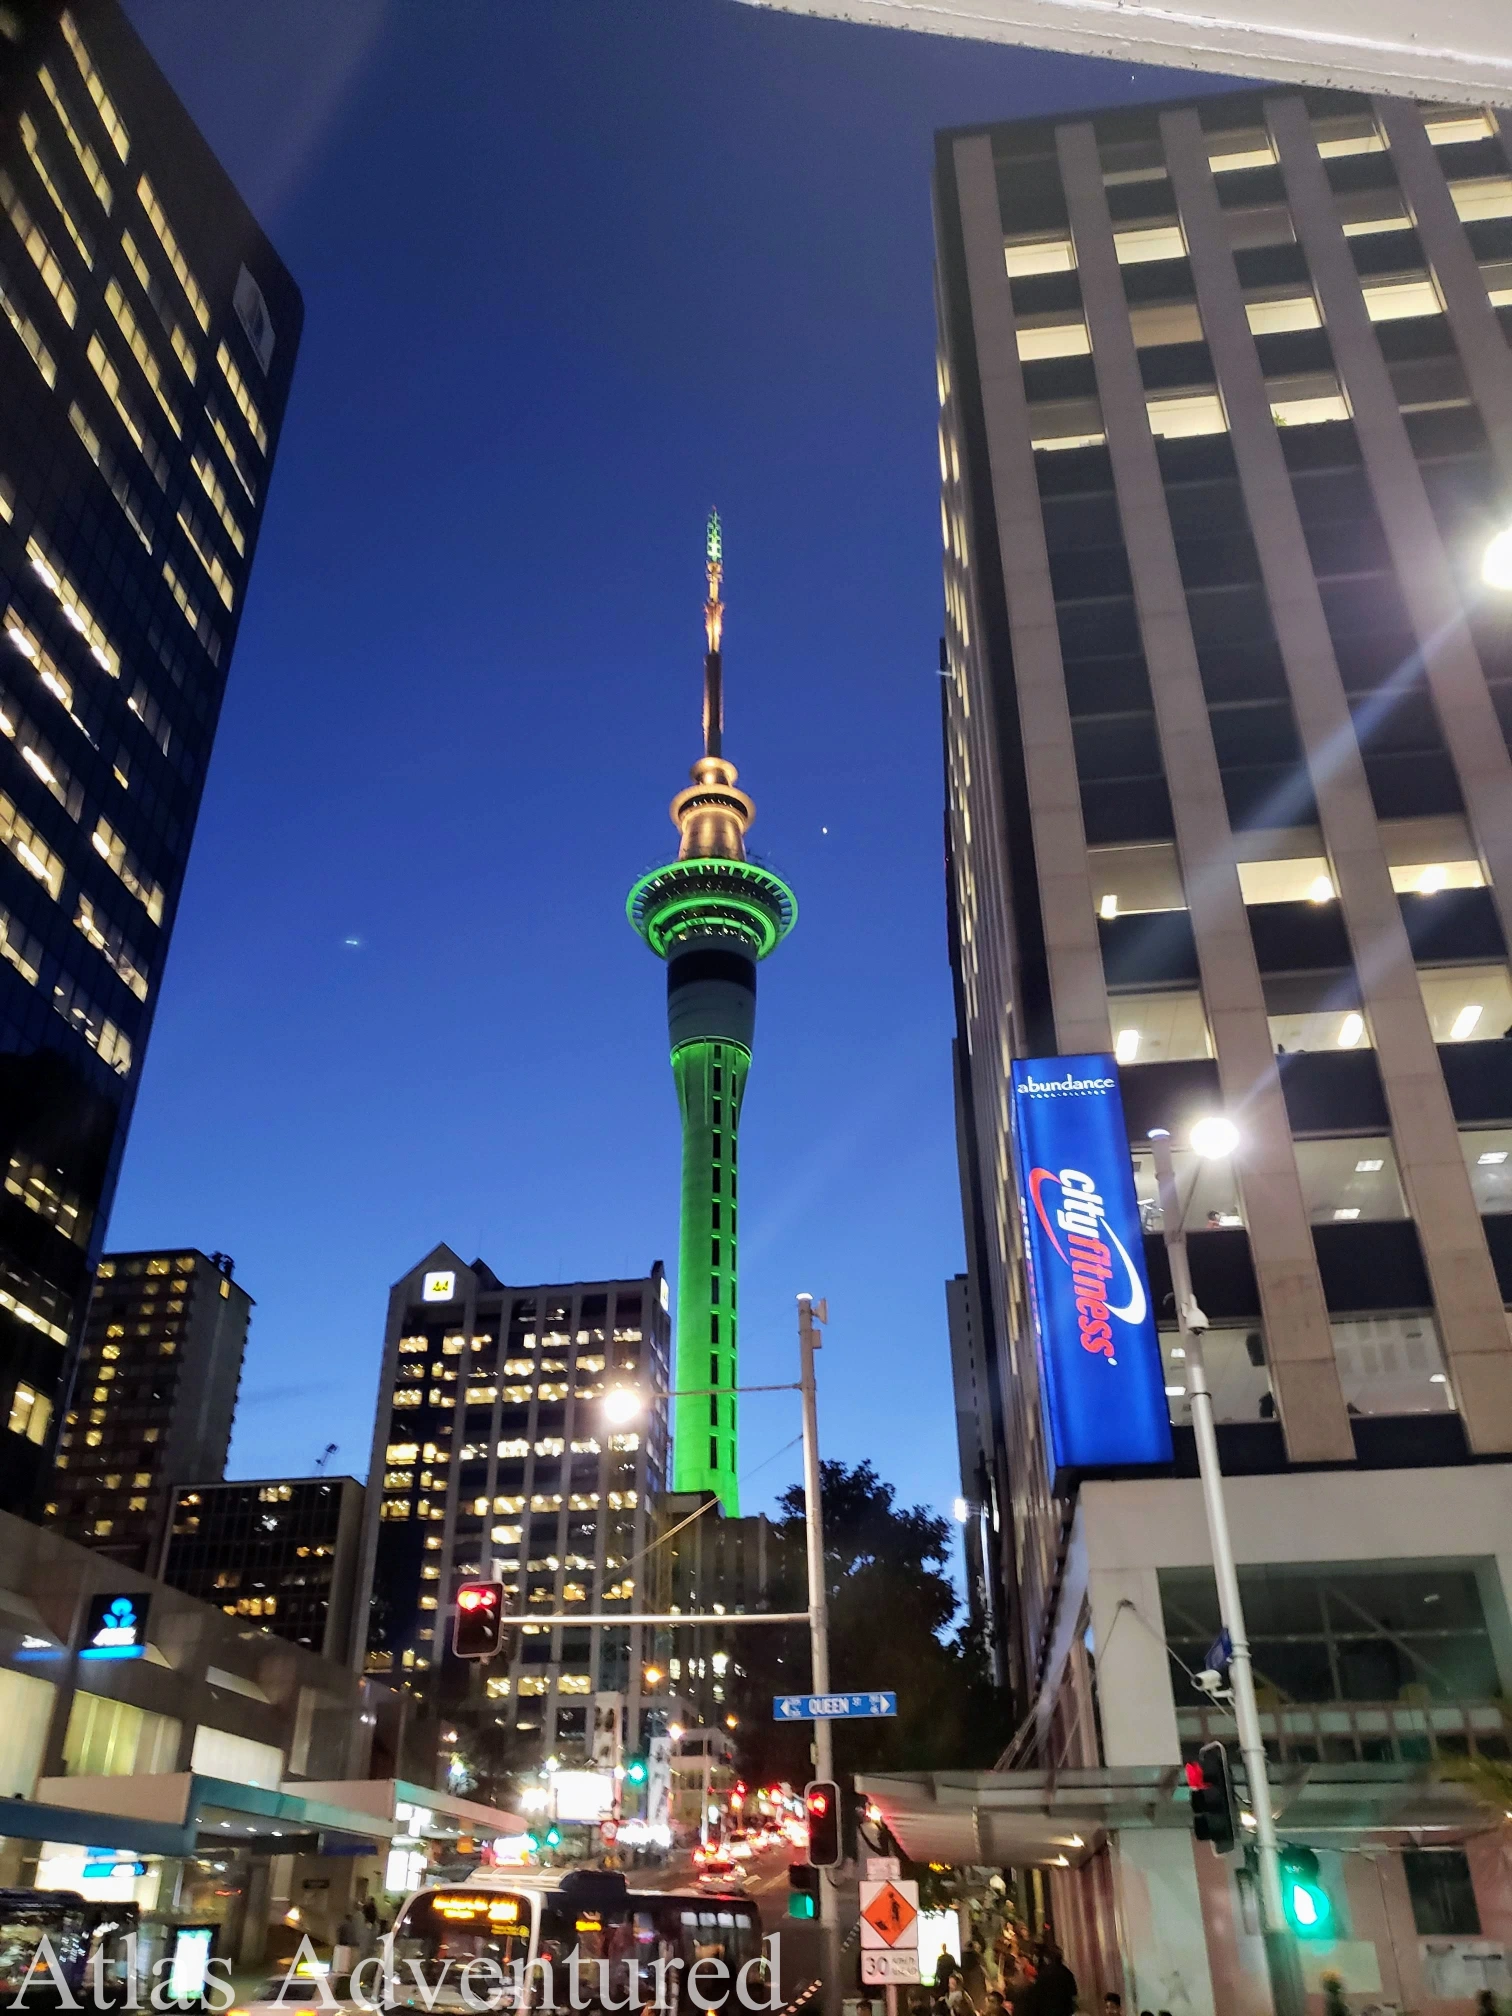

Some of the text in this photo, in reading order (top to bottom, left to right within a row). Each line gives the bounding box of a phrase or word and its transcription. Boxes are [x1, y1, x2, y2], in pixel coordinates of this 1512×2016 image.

[1017, 1073, 1115, 1094] abundance
[808, 1698, 849, 1715] QUEEN
[866, 1956, 889, 1976] 30
